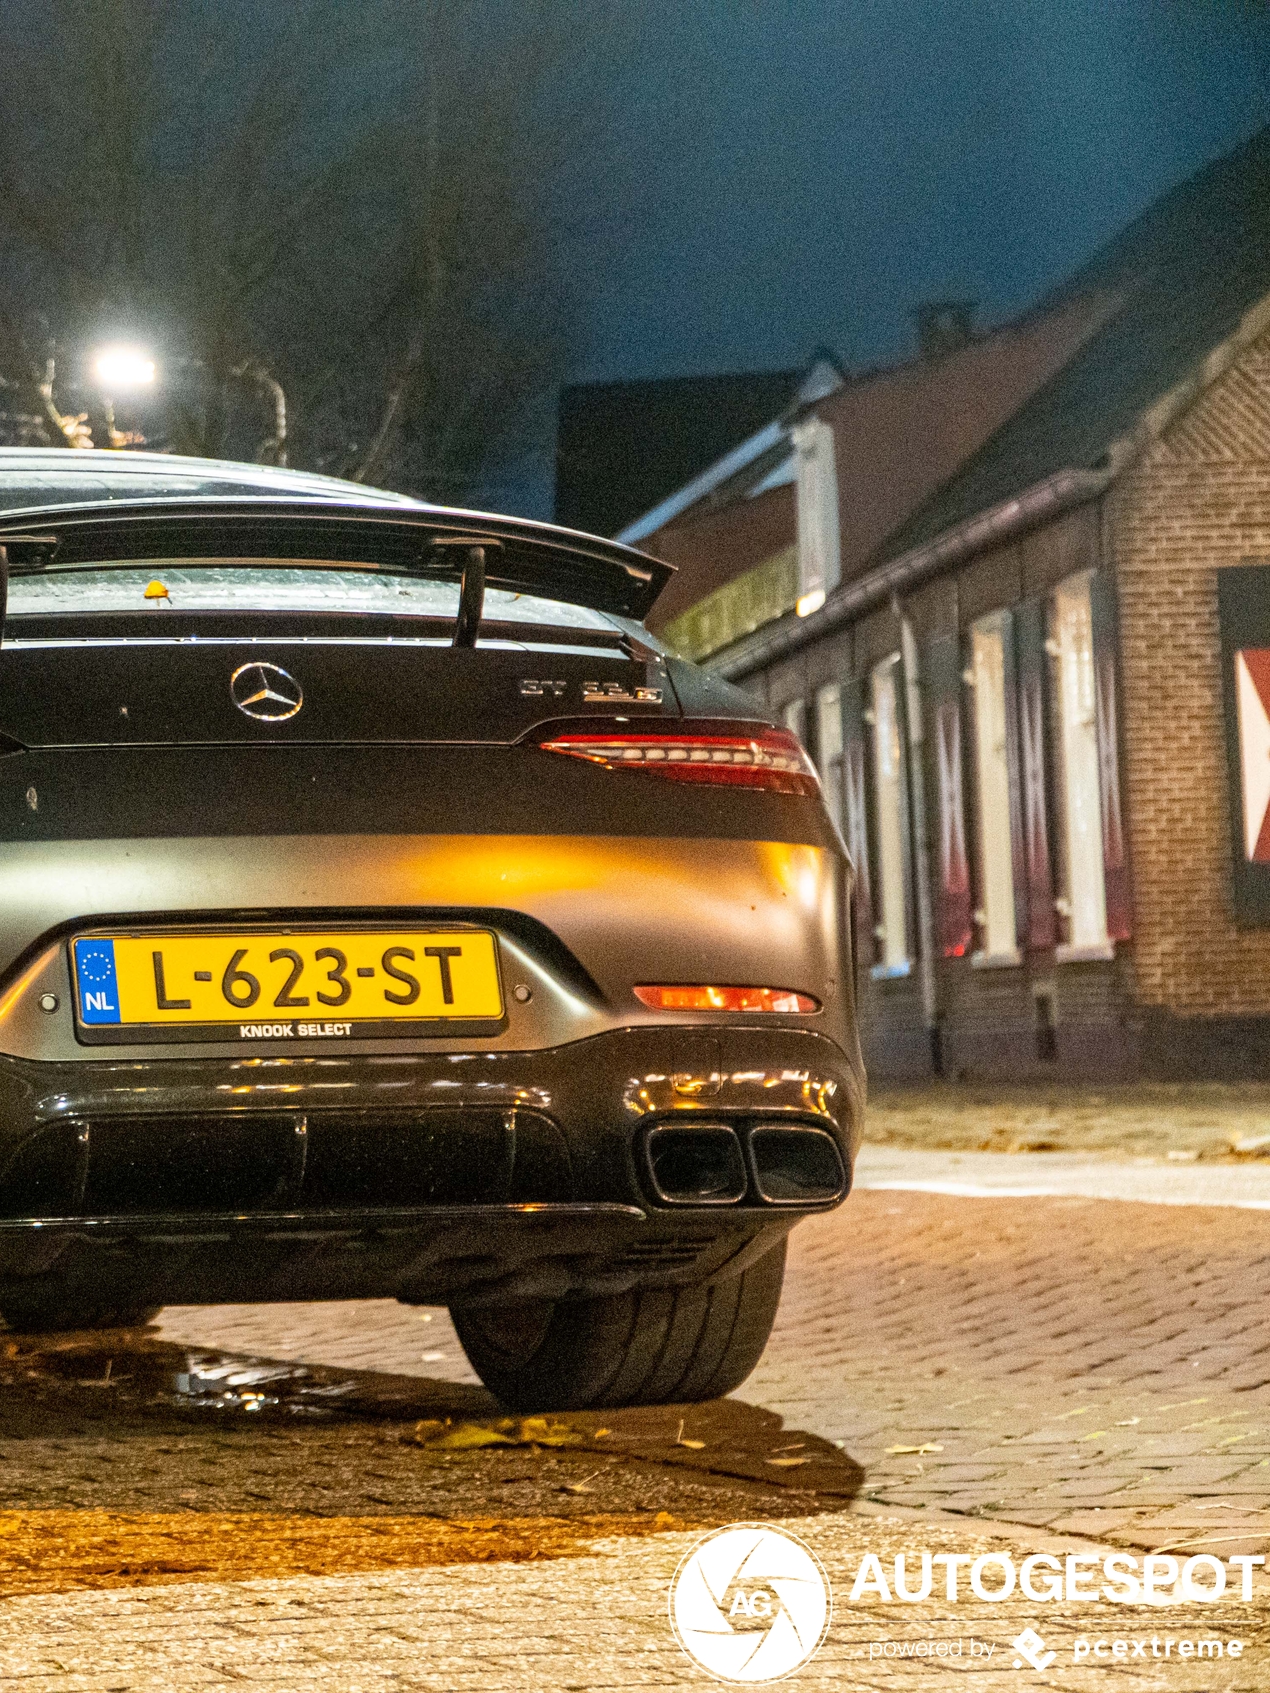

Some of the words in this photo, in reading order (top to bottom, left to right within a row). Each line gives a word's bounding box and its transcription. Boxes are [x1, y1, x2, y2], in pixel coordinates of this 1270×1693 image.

[152, 946, 462, 1010] L-623-ST
[85, 991, 115, 1011] NL
[240, 1025, 294, 1038] KNOOK
[298, 1023, 353, 1036] SELECT
